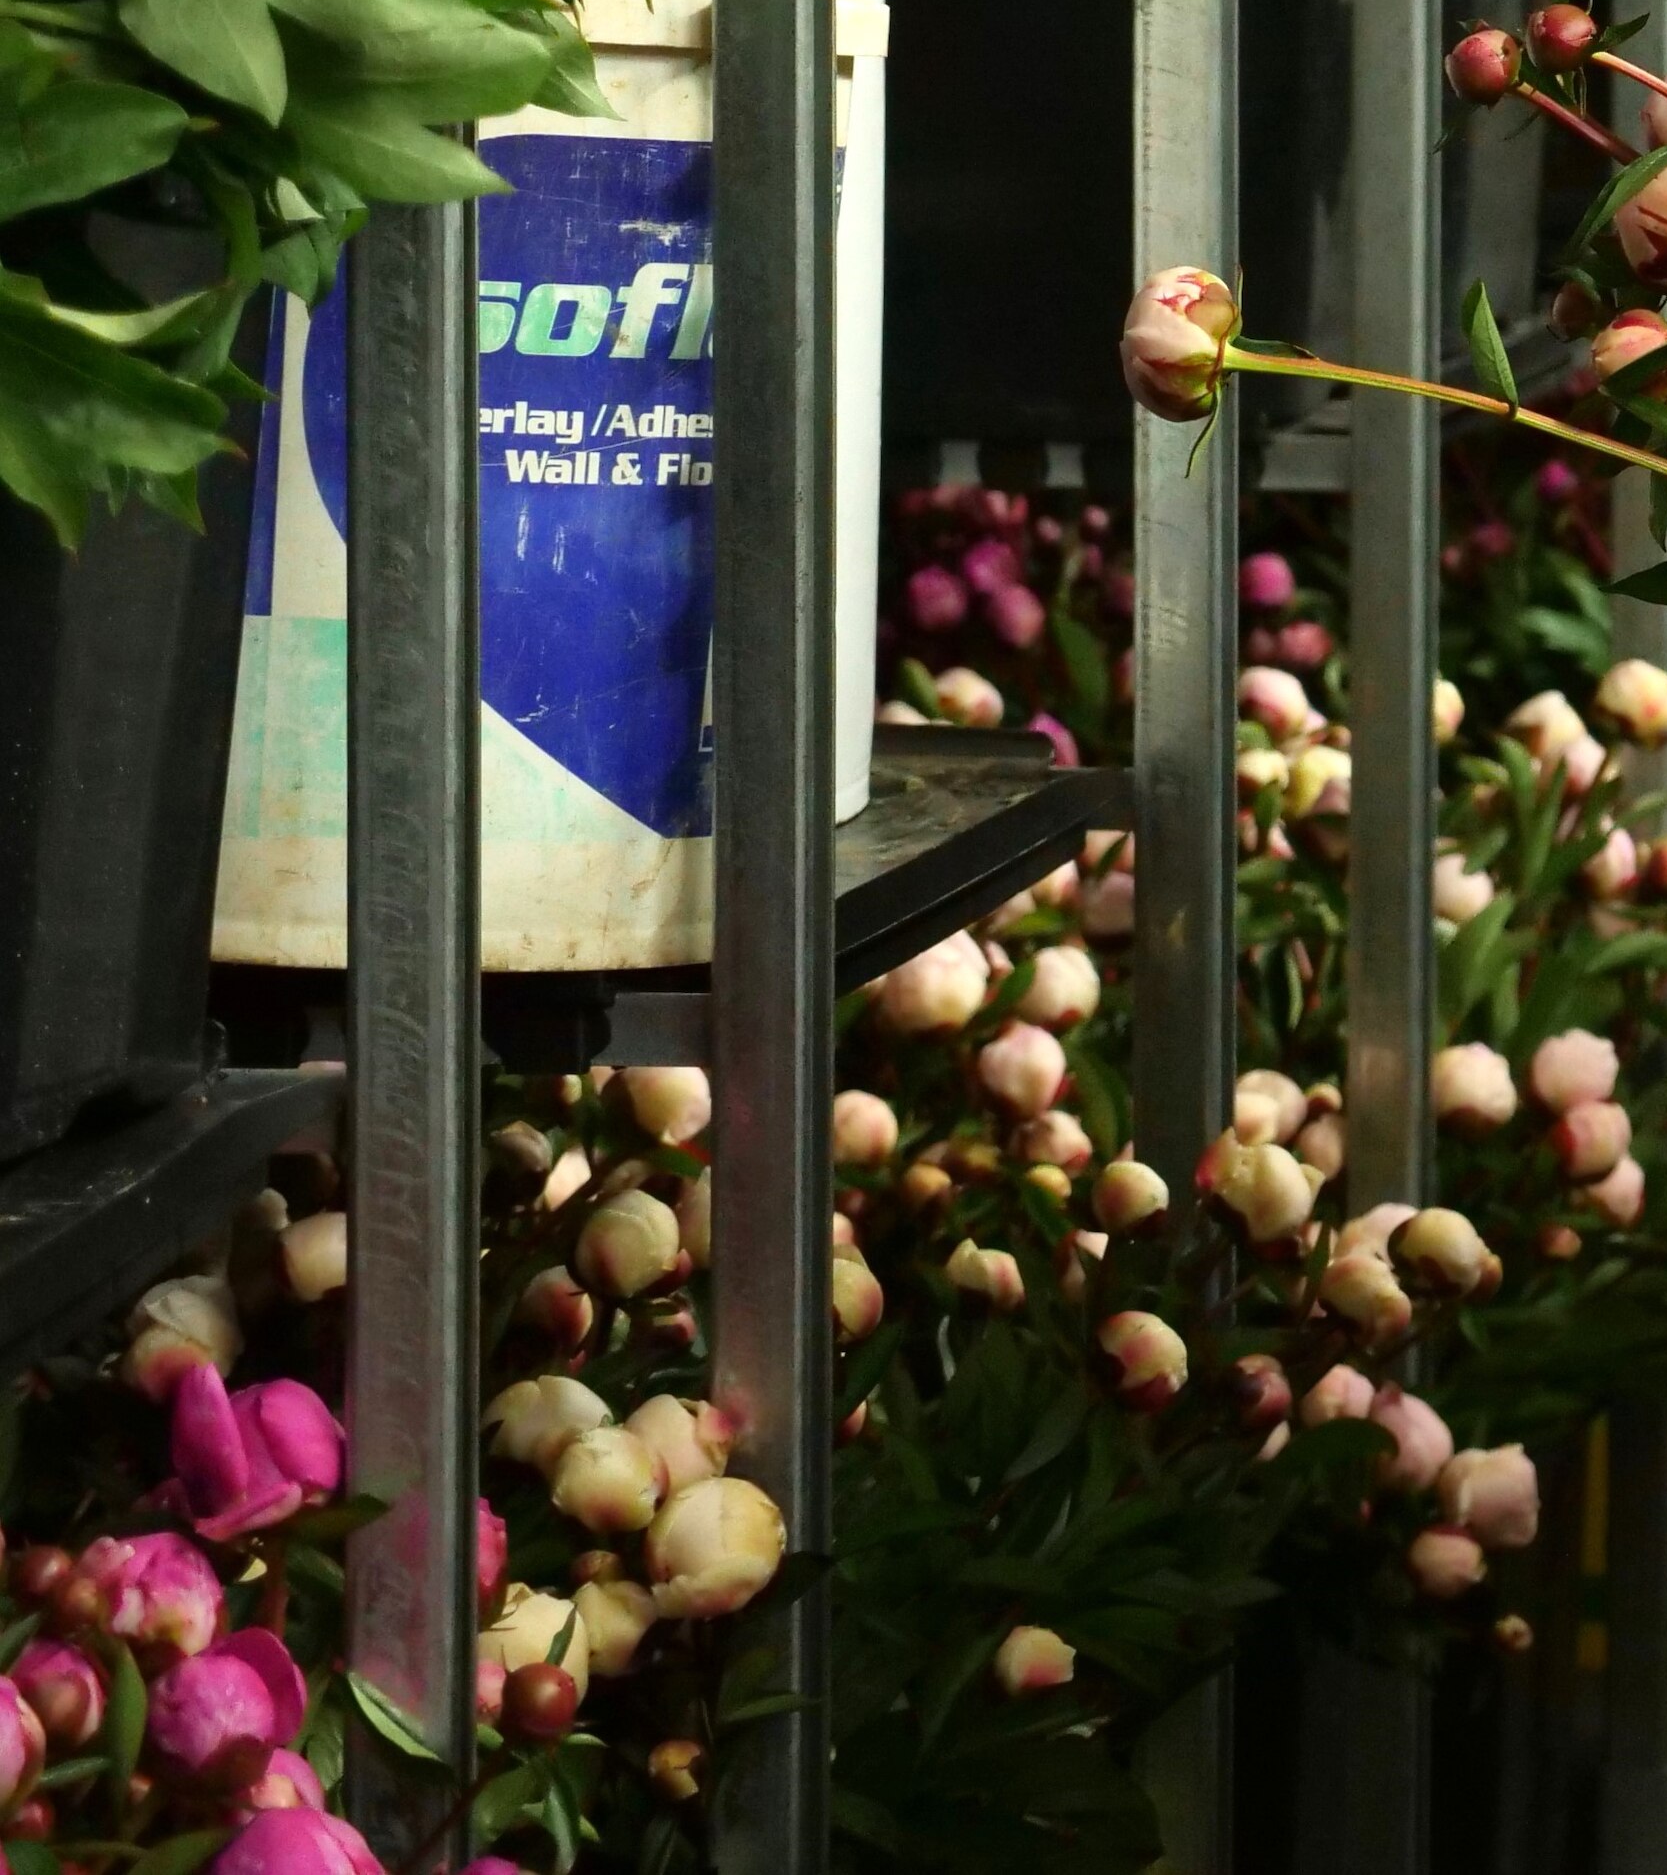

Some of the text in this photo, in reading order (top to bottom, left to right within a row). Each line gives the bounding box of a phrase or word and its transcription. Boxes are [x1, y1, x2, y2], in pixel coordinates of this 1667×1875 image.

[479, 262, 713, 360] sofl
[505, 449, 600, 484] Wall
[611, 453, 643, 485] &
